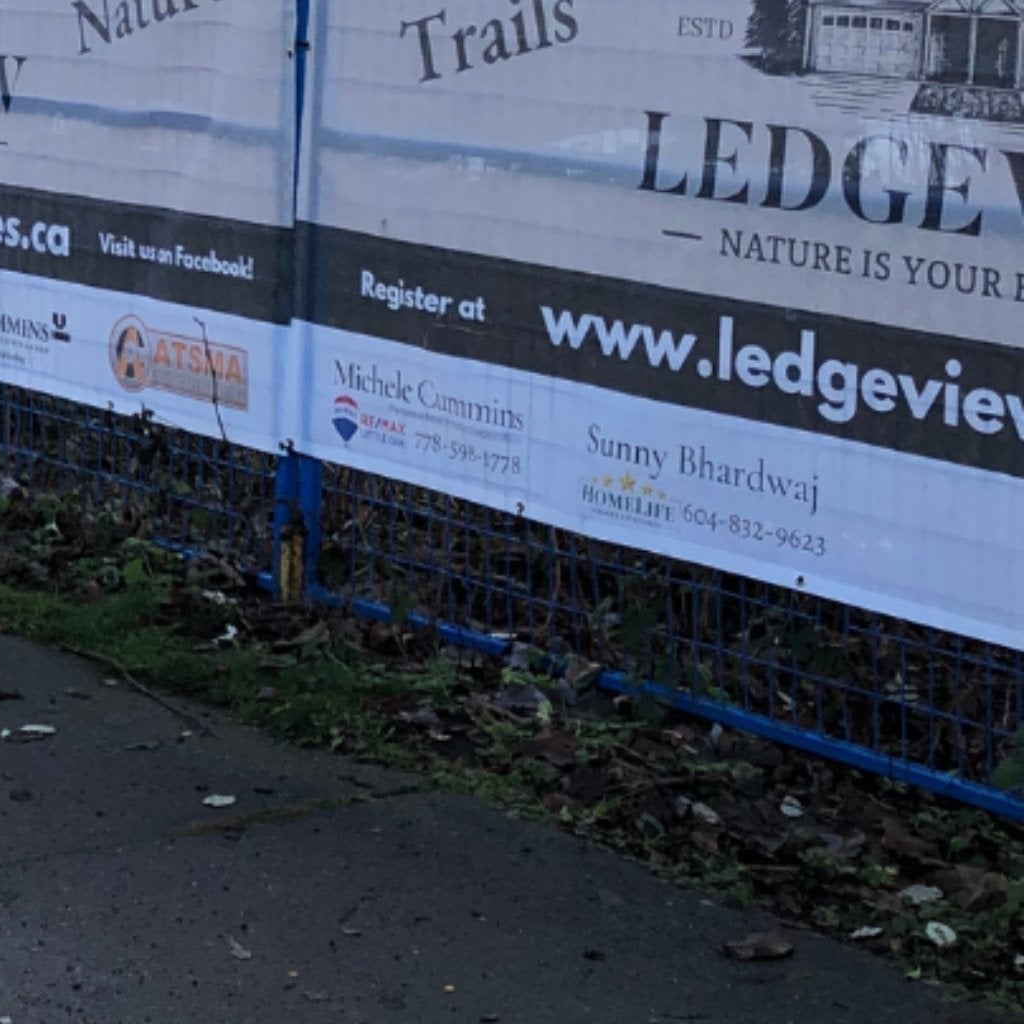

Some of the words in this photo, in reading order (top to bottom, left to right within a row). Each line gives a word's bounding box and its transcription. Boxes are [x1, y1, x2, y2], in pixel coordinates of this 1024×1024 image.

[677, 16, 734, 40] ESTD
[98, 231, 136, 258] Visit
[719, 228, 853, 275] NATURE
[861, 249, 891, 281] IS
[902, 254, 1003, 299] YOUR
[361, 270, 454, 316] Register
[458, 296, 487, 323] at
[334, 360, 413, 405] Michele
[417, 380, 525, 431] Cummins
[587, 423, 668, 480] Sunny
[678, 444, 819, 516] Bhardwaj
[682, 503, 826, 557] 604-832-9623
